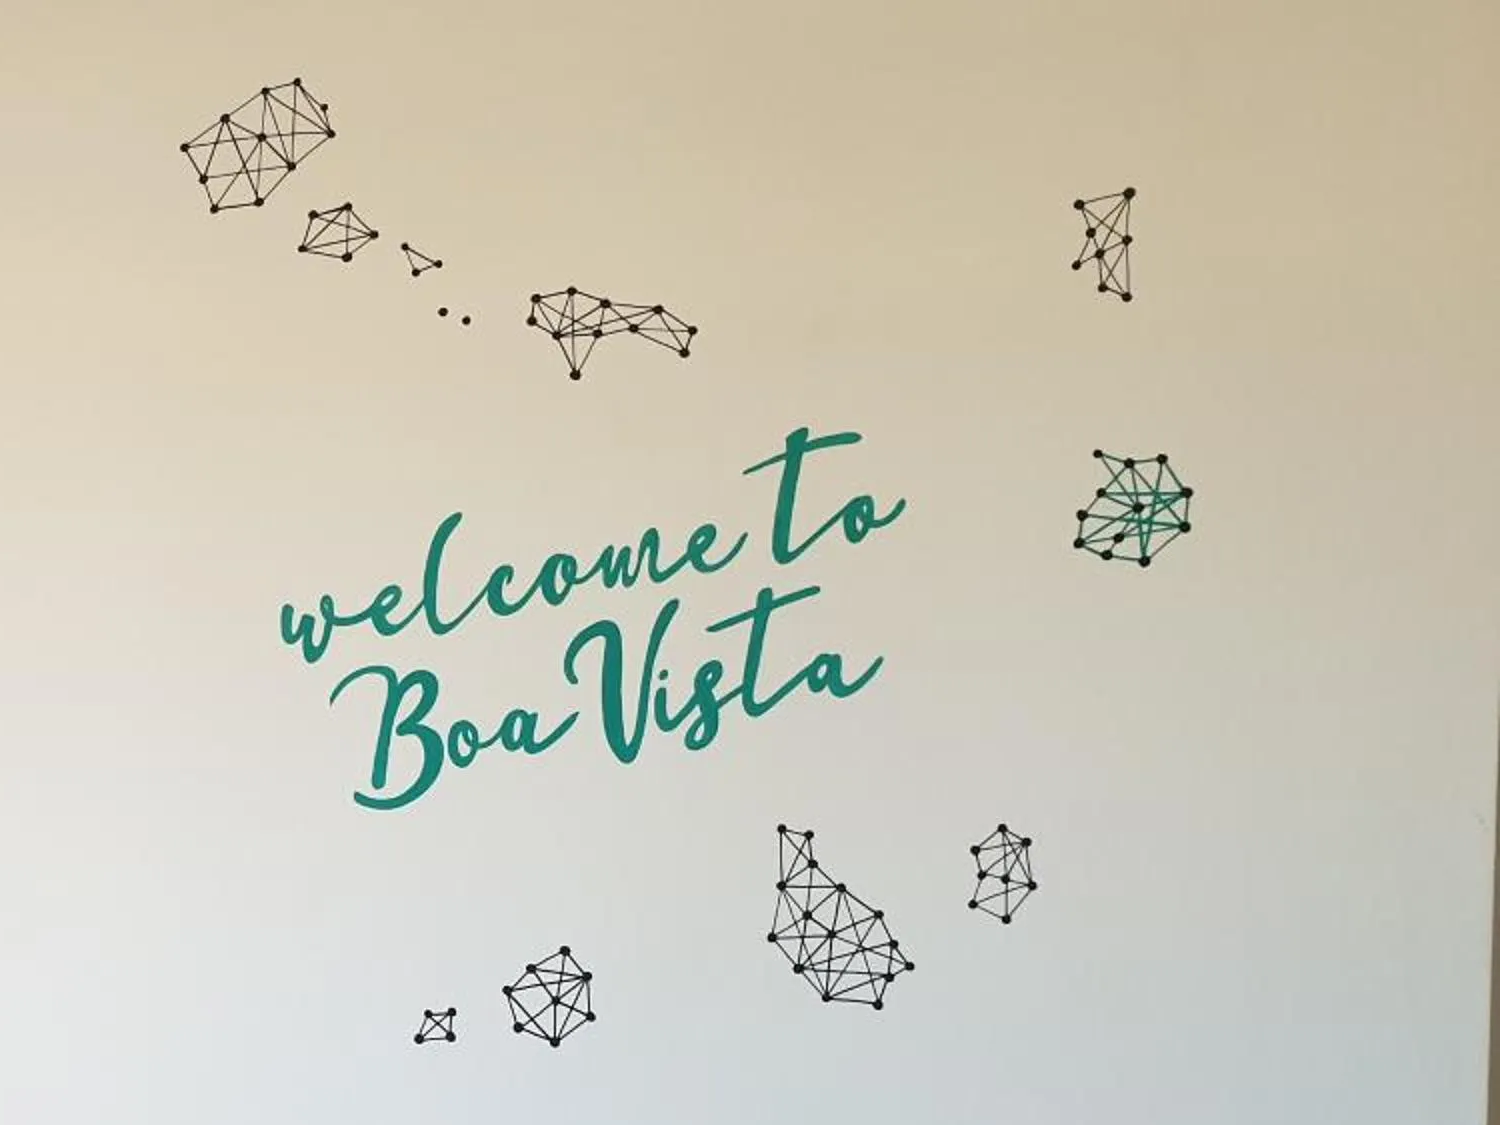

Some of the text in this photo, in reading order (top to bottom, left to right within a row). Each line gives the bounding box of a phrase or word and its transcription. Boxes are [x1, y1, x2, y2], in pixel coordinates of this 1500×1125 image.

[280, 426, 906, 663] welcome to
[329, 585, 885, 811] Boa Vista
